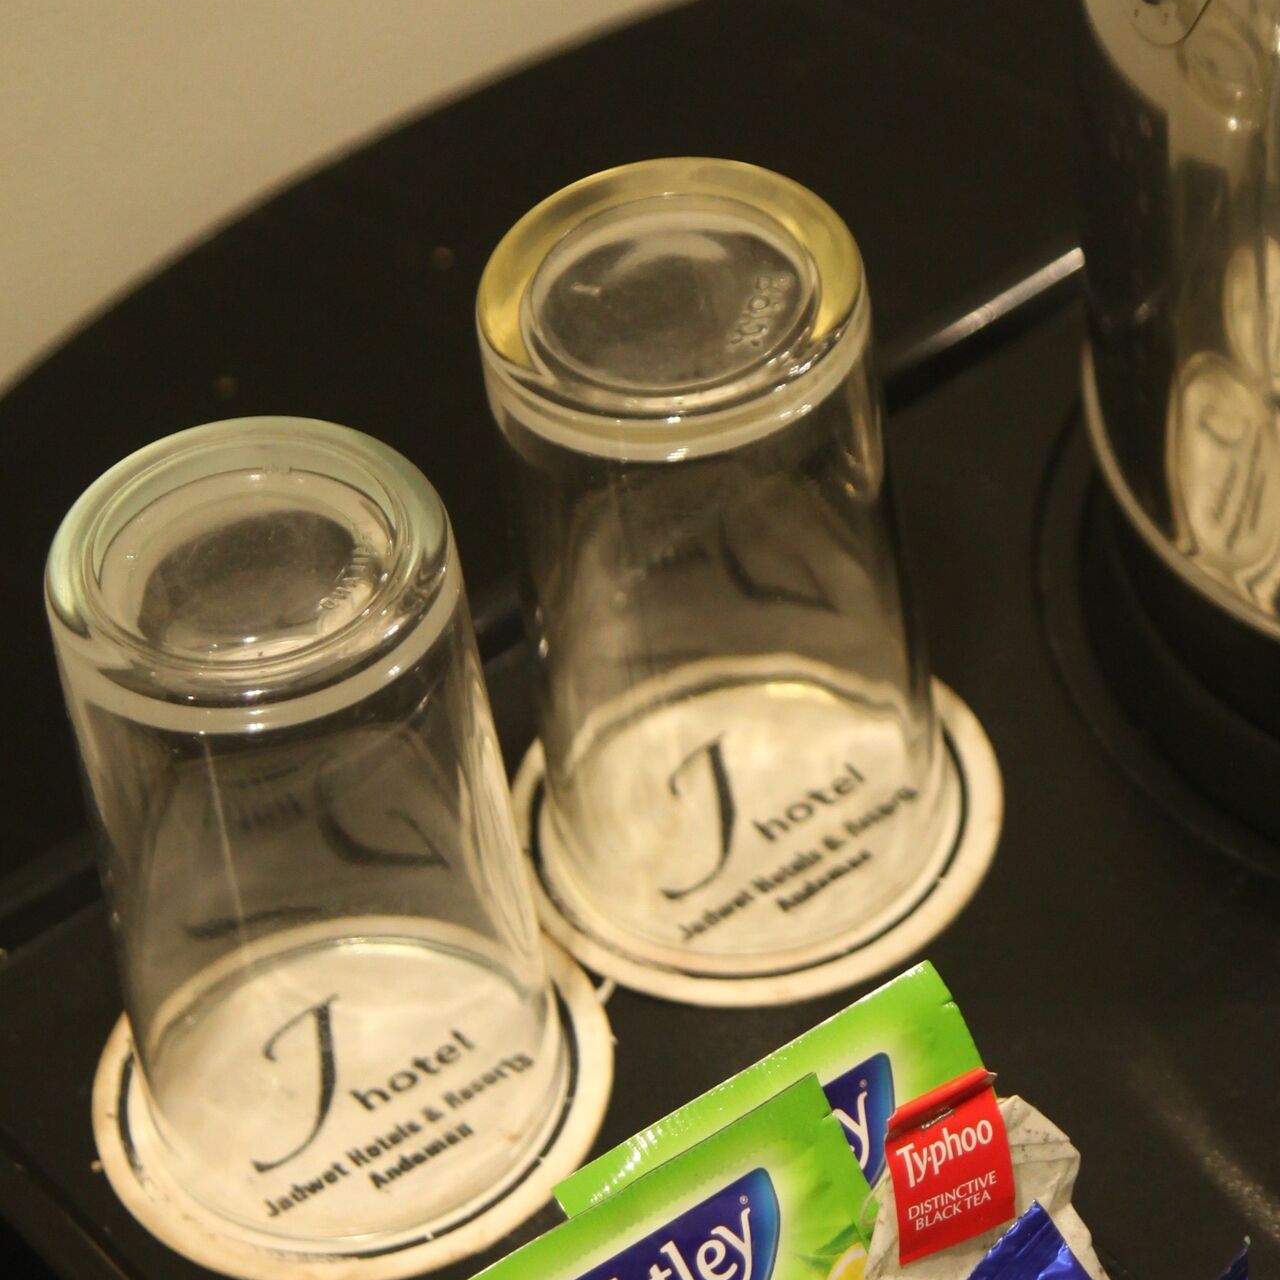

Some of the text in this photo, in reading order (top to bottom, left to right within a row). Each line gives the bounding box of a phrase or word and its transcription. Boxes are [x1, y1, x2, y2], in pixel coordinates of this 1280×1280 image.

[752, 763, 865, 843] hotel
[251, 993, 475, 1173] J hotel
[347, 1122, 422, 1168] Hotels
[908, 1170, 998, 1221] DISTINCTIVE
[915, 1190, 992, 1231] BLACK TEA
